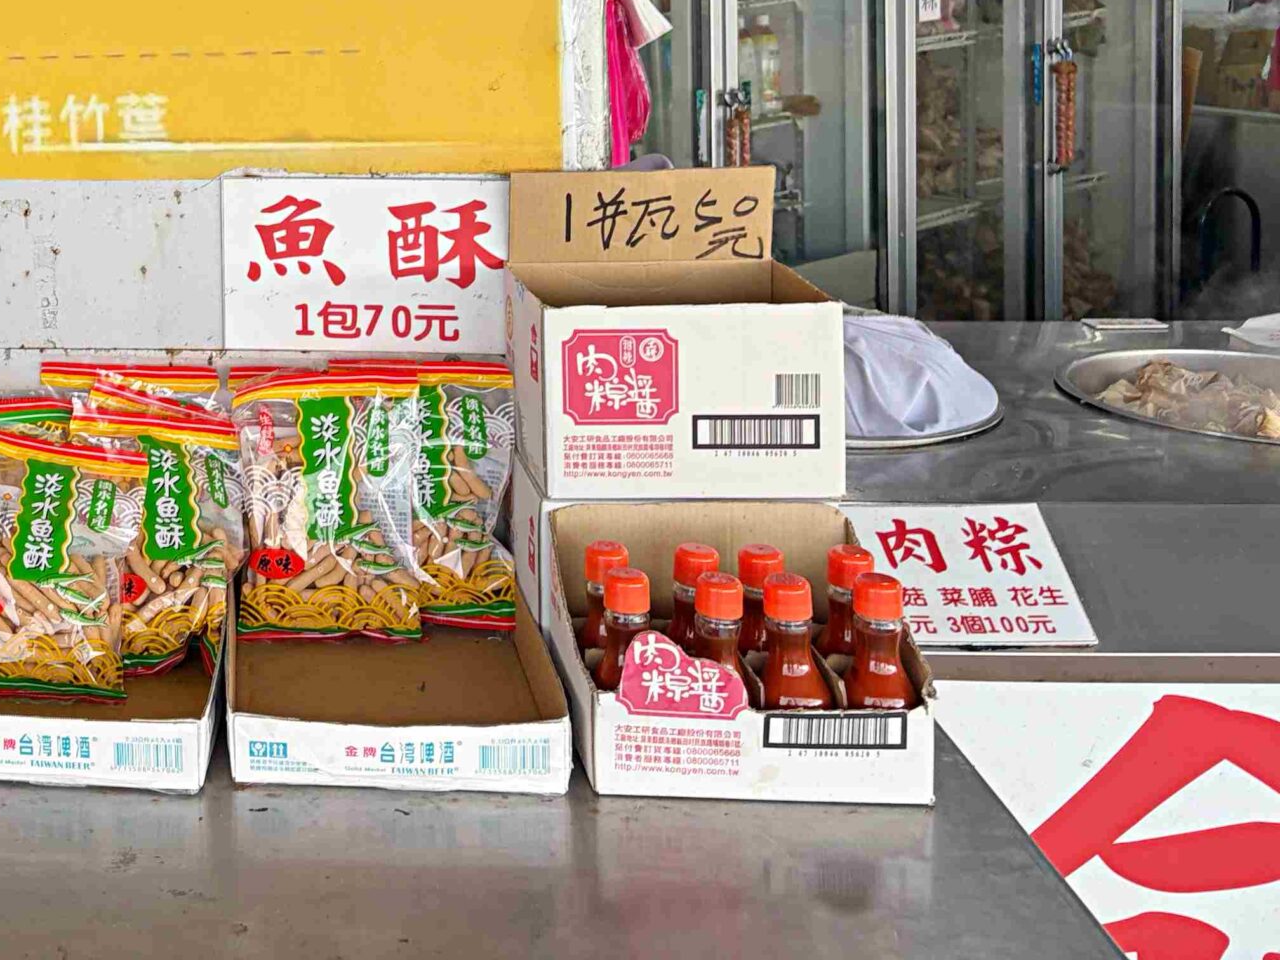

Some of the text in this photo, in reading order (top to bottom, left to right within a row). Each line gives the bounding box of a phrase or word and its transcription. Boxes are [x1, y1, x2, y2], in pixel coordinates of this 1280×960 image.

[1, 92, 170, 154] 桂竹葉
[246, 194, 506, 289] 魚酥
[294, 302, 460, 341] 1包70元
[150, 449, 186, 550] 淡水魚酥
[310, 413, 345, 529] 淡水魚酥
[22, 473, 65, 572] 淡水魚酥
[875, 516, 1043, 576] 肉粽
[256, 555, 293, 573] 原味
[902, 615, 1057, 635] 元 3個100元
